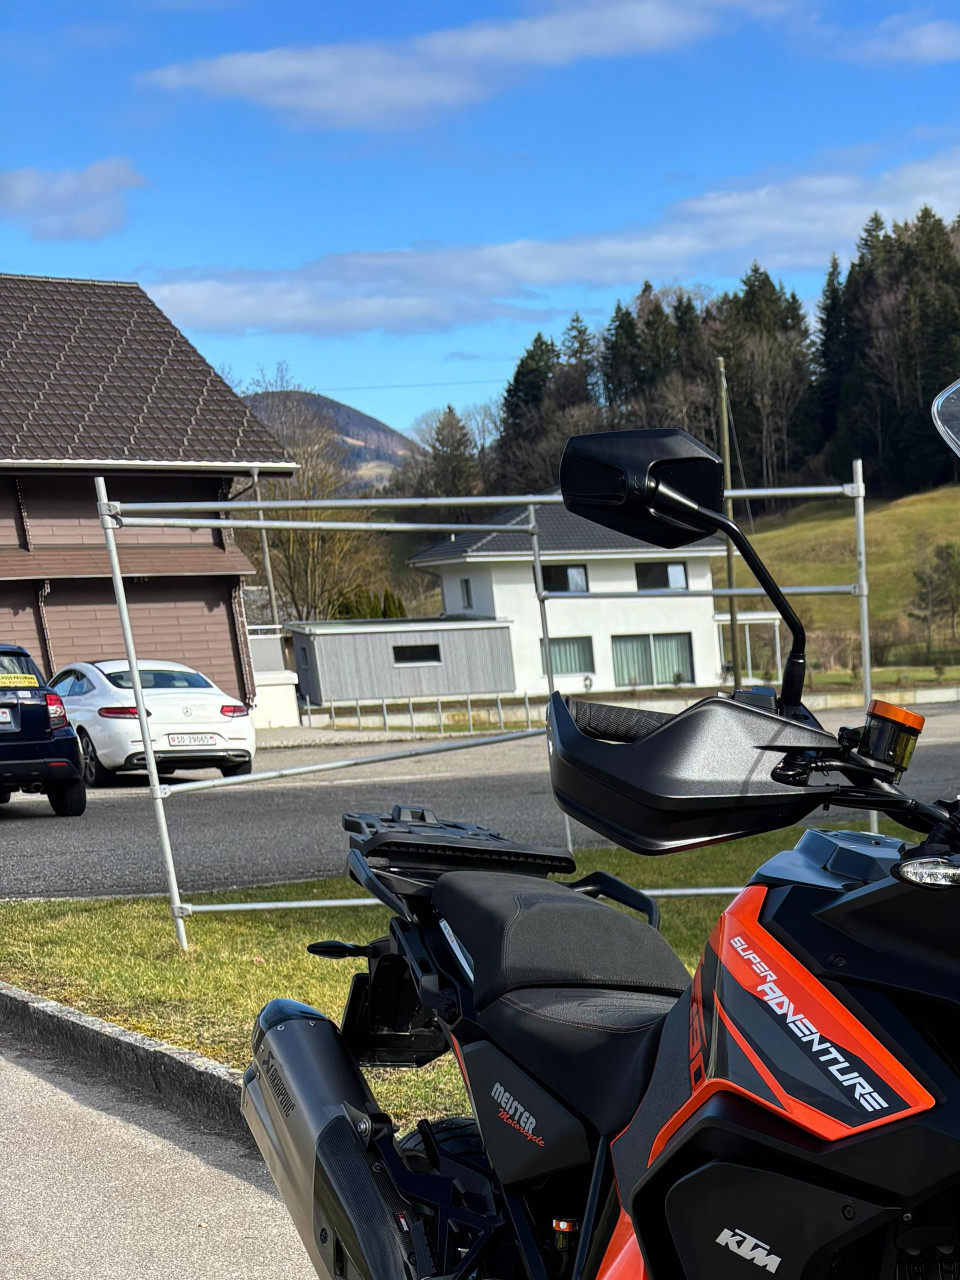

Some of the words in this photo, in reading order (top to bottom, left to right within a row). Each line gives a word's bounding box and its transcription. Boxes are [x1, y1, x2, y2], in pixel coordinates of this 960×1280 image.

[730, 936, 777, 982] SUPER
[756, 981, 889, 1112] ADVENTURE
[490, 1081, 537, 1135] MEISTER
[497, 1108, 545, 1147] Motorcycle
[715, 1228, 782, 1274] KTM
